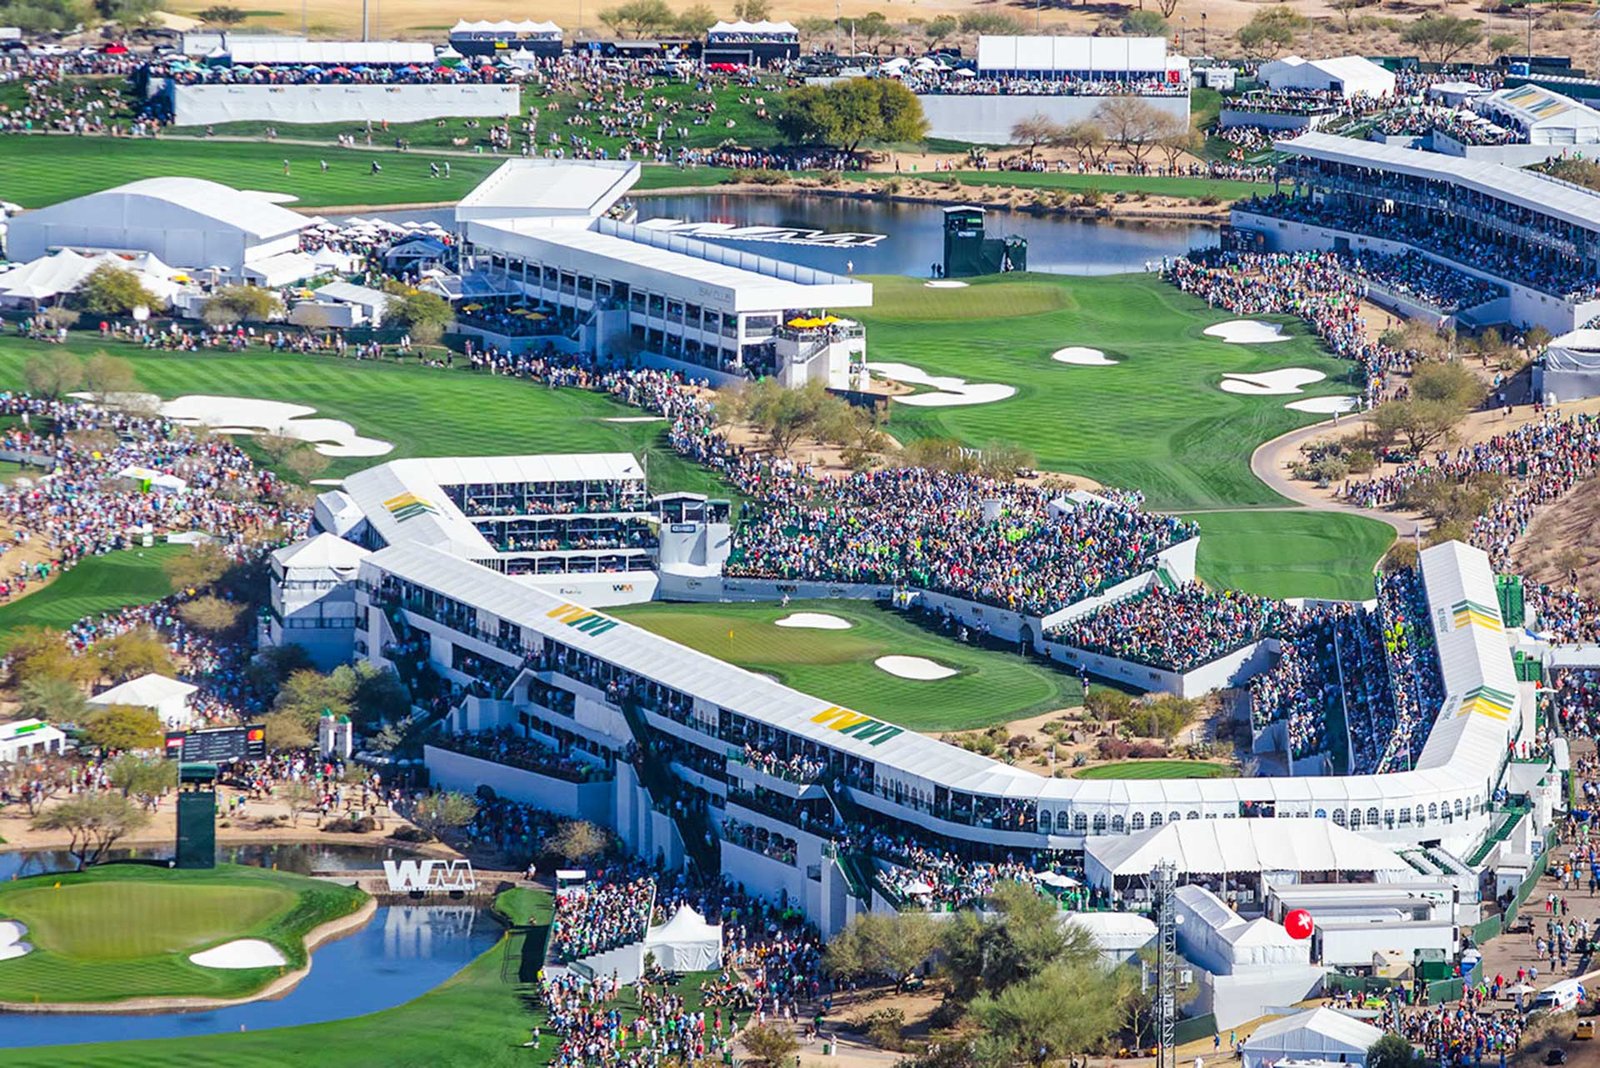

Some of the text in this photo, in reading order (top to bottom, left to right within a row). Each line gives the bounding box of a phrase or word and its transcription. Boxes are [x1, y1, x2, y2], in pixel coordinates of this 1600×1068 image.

[612, 584, 634, 592] WM
[546, 603, 620, 637] WM
[809, 706, 905, 747] WM
[383, 860, 476, 891] WM
